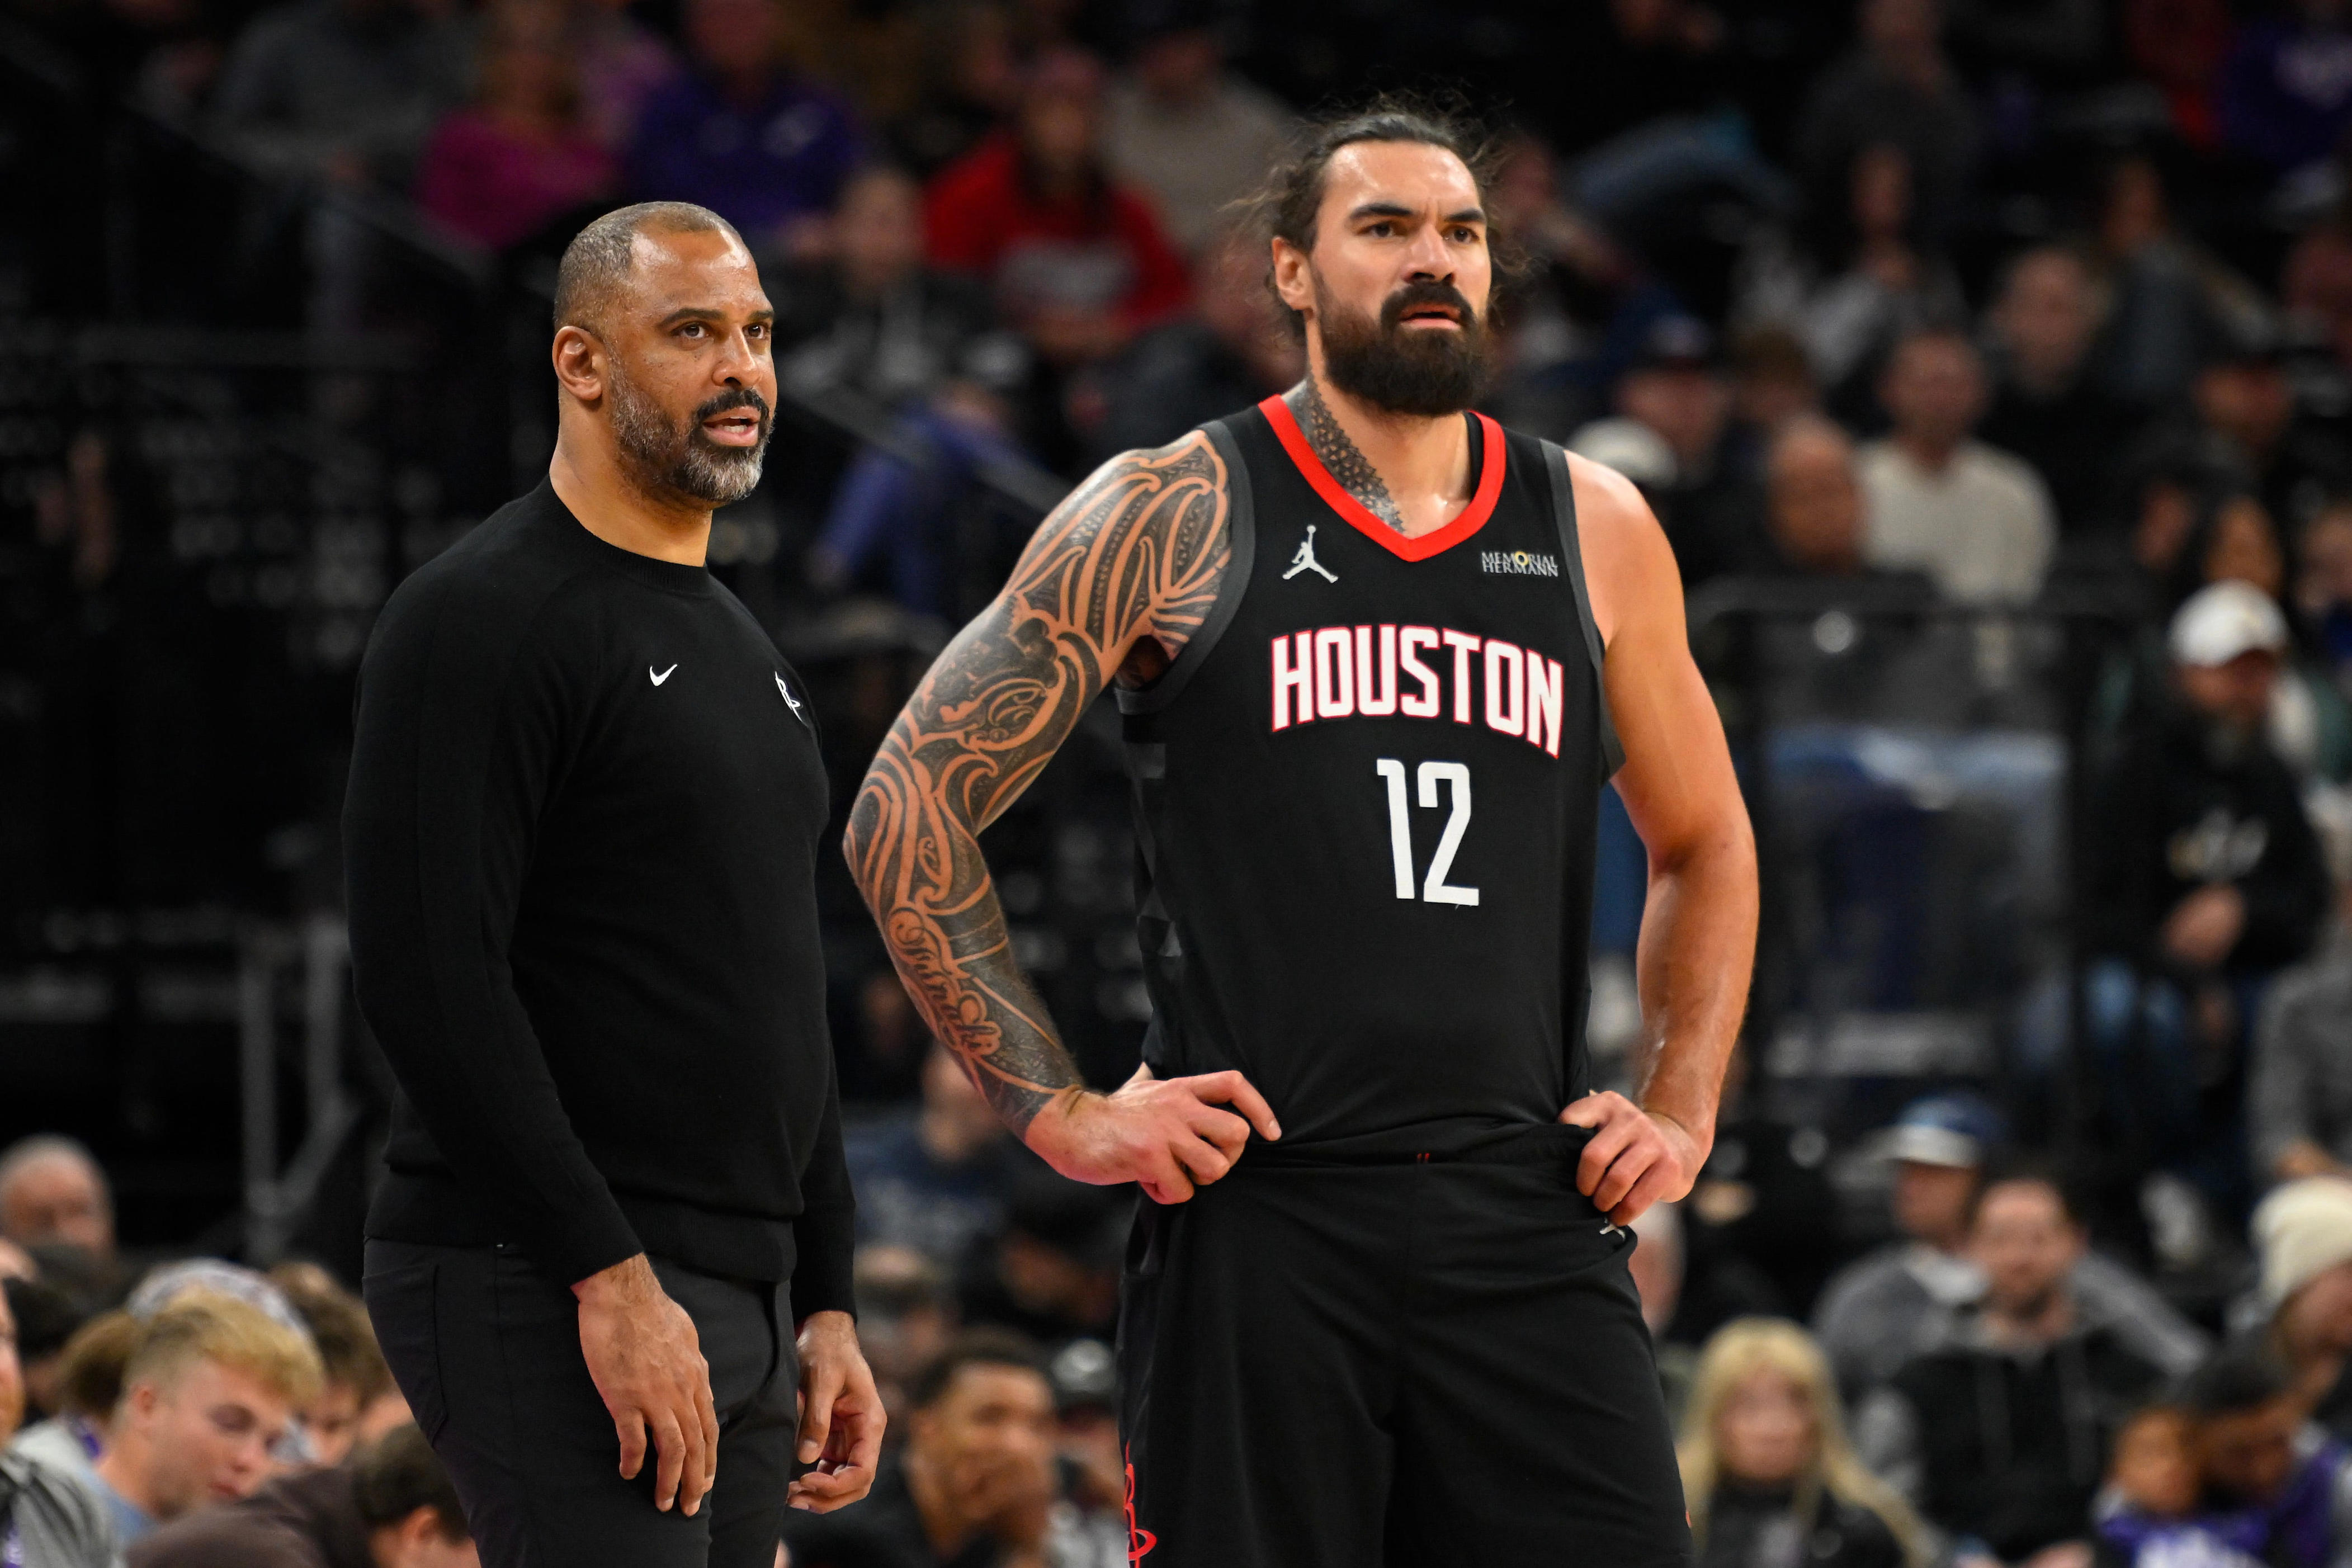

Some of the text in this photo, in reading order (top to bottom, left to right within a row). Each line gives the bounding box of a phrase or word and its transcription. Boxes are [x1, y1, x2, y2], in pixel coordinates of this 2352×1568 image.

[1481, 550, 1558, 568] MEMORIAL
[1482, 561, 1558, 578] HERMANN
[1271, 623, 1564, 760] HOUSTON
[1377, 758, 1480, 906] 12
